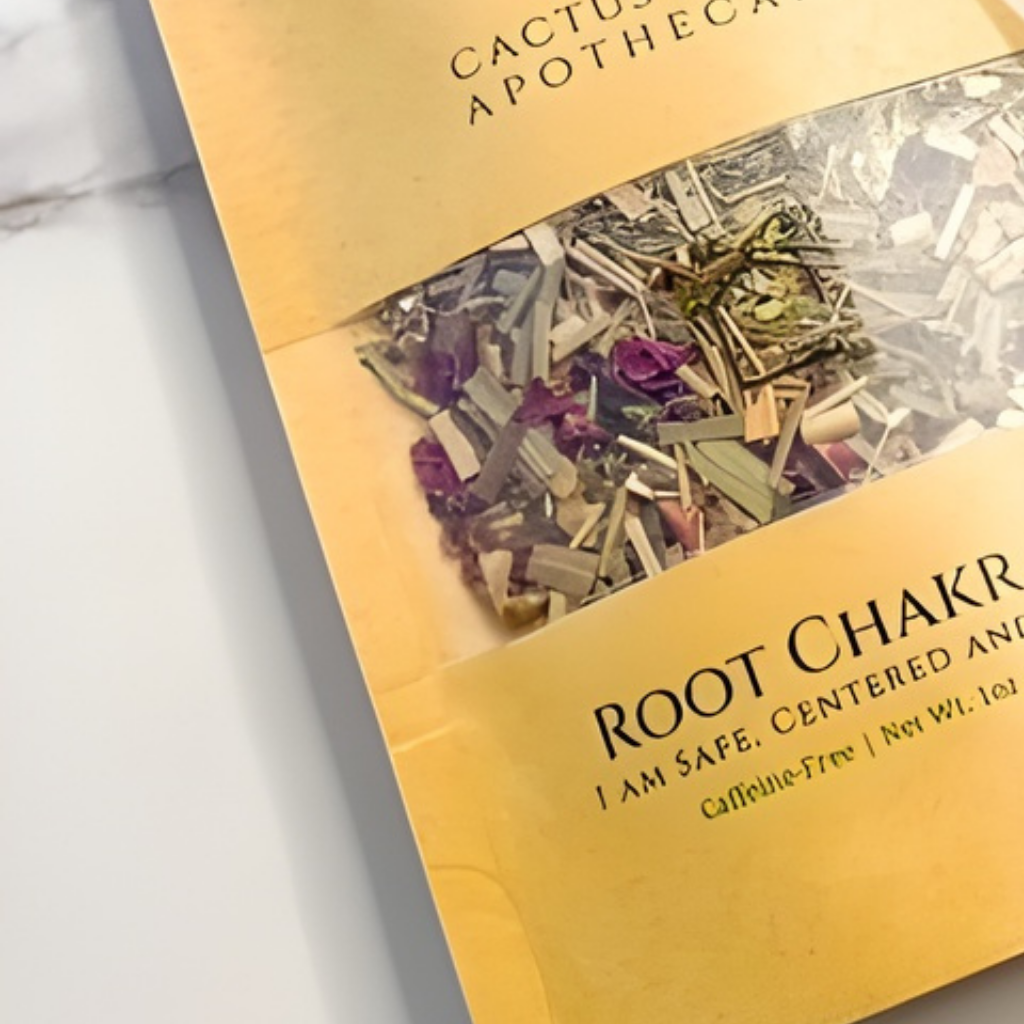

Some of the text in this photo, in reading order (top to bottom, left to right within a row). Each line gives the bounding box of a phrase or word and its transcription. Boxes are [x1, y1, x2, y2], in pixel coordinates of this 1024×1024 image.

[594, 645, 765, 760] ROOT
[596, 785, 607, 810] I
[621, 766, 667, 803] AM
[770, 648, 951, 734] CENTERED
